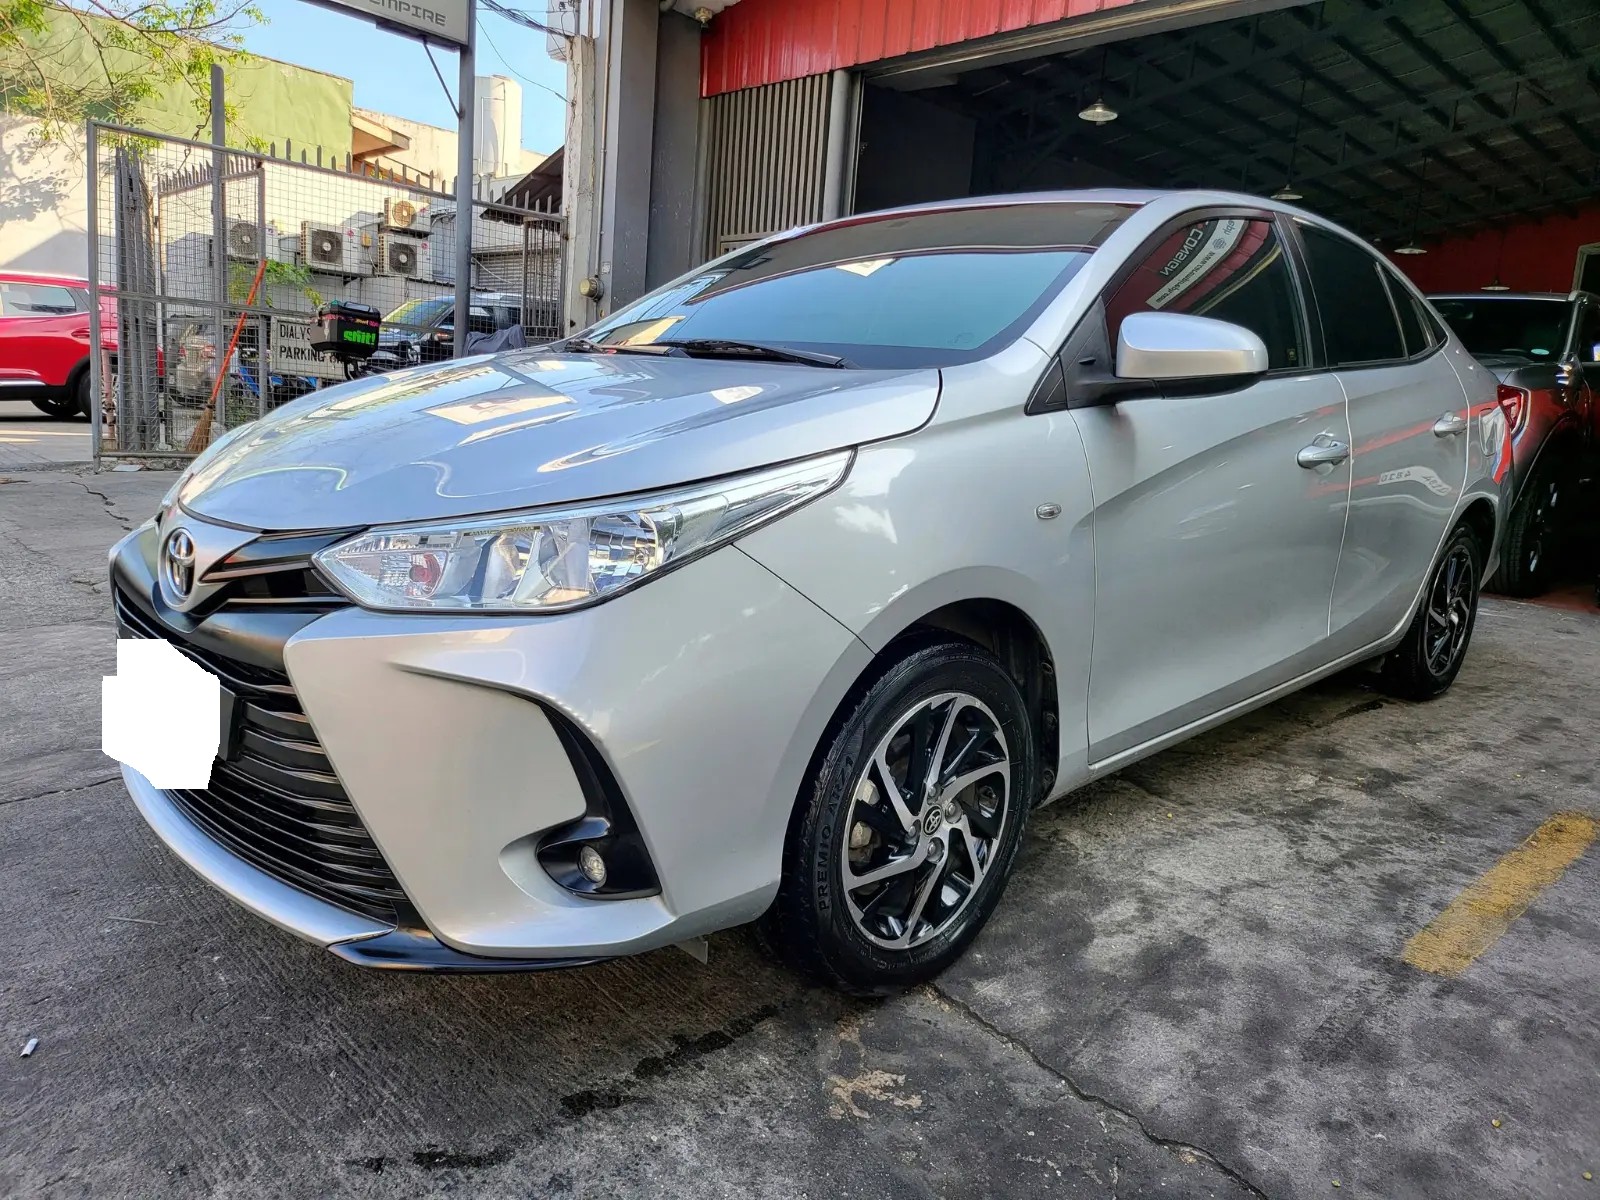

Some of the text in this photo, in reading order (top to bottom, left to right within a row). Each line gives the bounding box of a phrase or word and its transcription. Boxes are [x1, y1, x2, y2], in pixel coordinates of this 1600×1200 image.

[369, 0, 446, 26] MPIRE
[280, 324, 311, 340] DIALYS
[280, 344, 325, 362] PARKING
[816, 823, 832, 911] PREMIO
